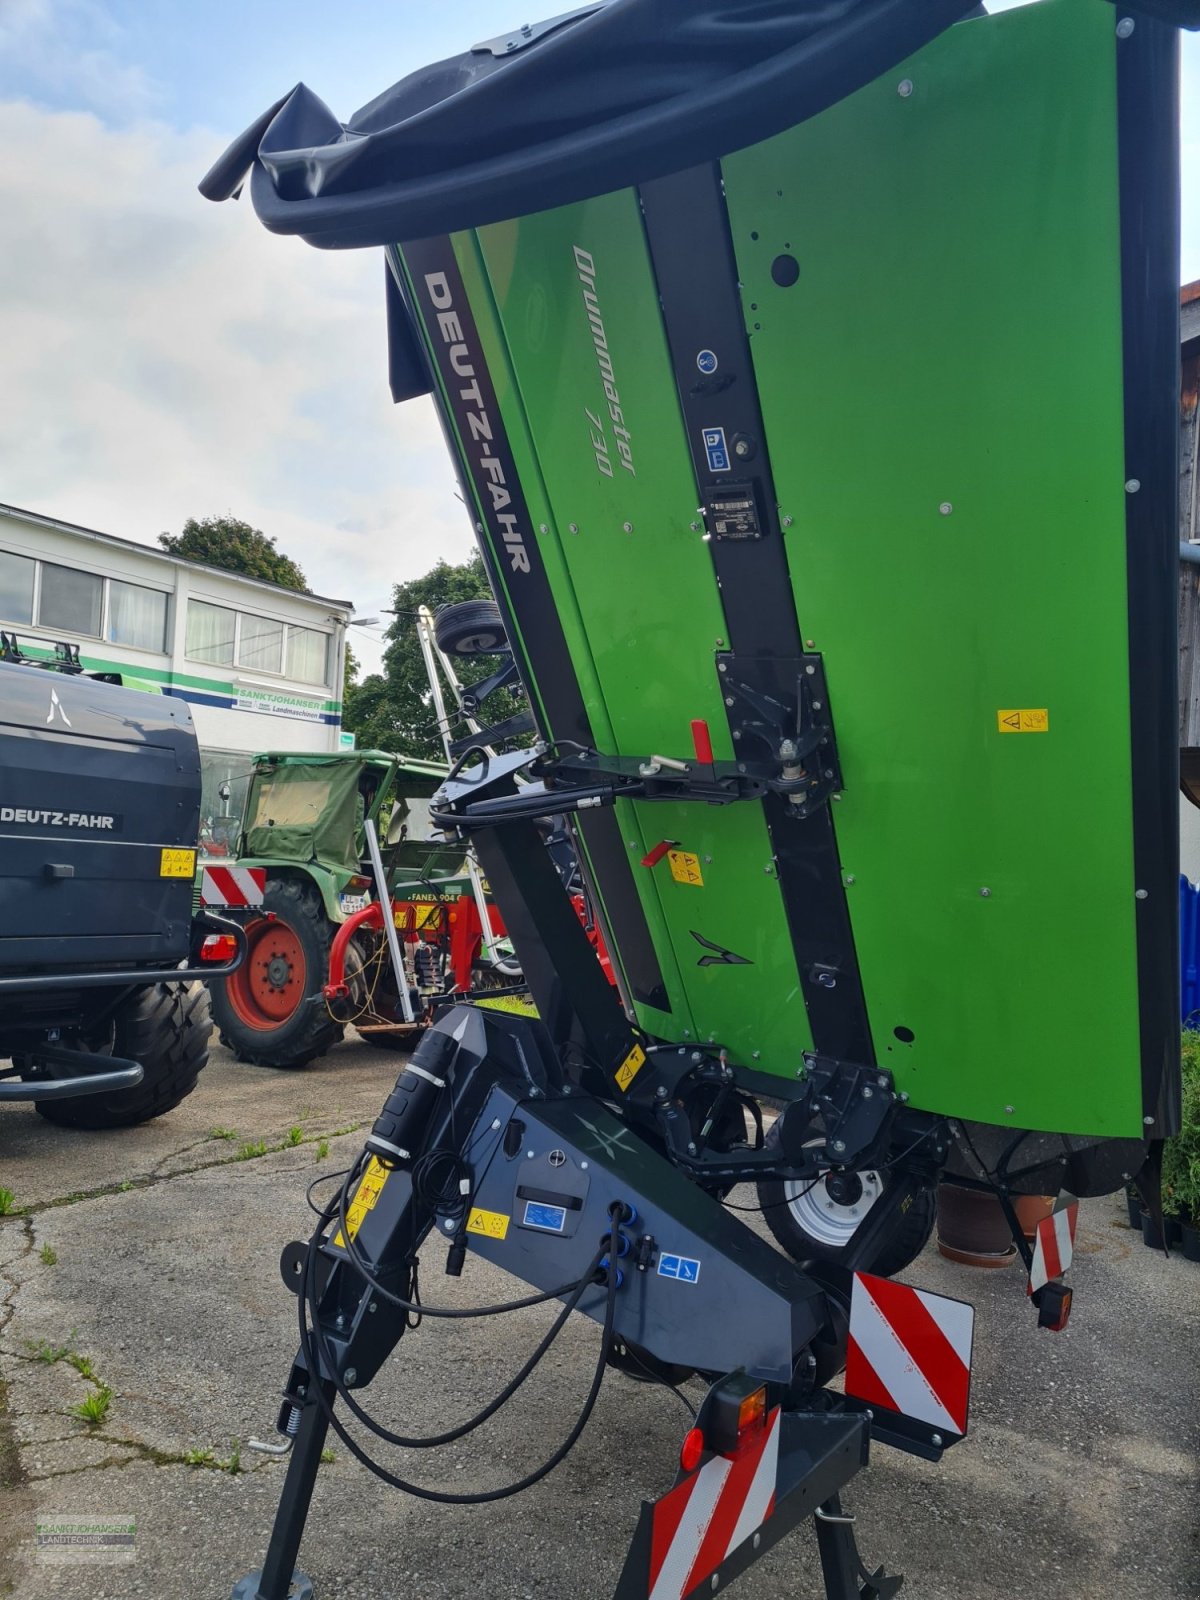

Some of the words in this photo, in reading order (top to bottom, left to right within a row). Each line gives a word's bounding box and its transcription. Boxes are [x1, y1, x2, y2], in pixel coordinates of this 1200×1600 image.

[573, 245, 636, 478] Drummaster
[424, 271, 532, 574] DEUTZ-FAHR
[584, 407, 614, 478] 730
[239, 689, 320, 710] SANKTJOHANSER
[272, 705, 319, 719] Landmaschinen
[0, 807, 114, 829] DEUTZ-FAHR
